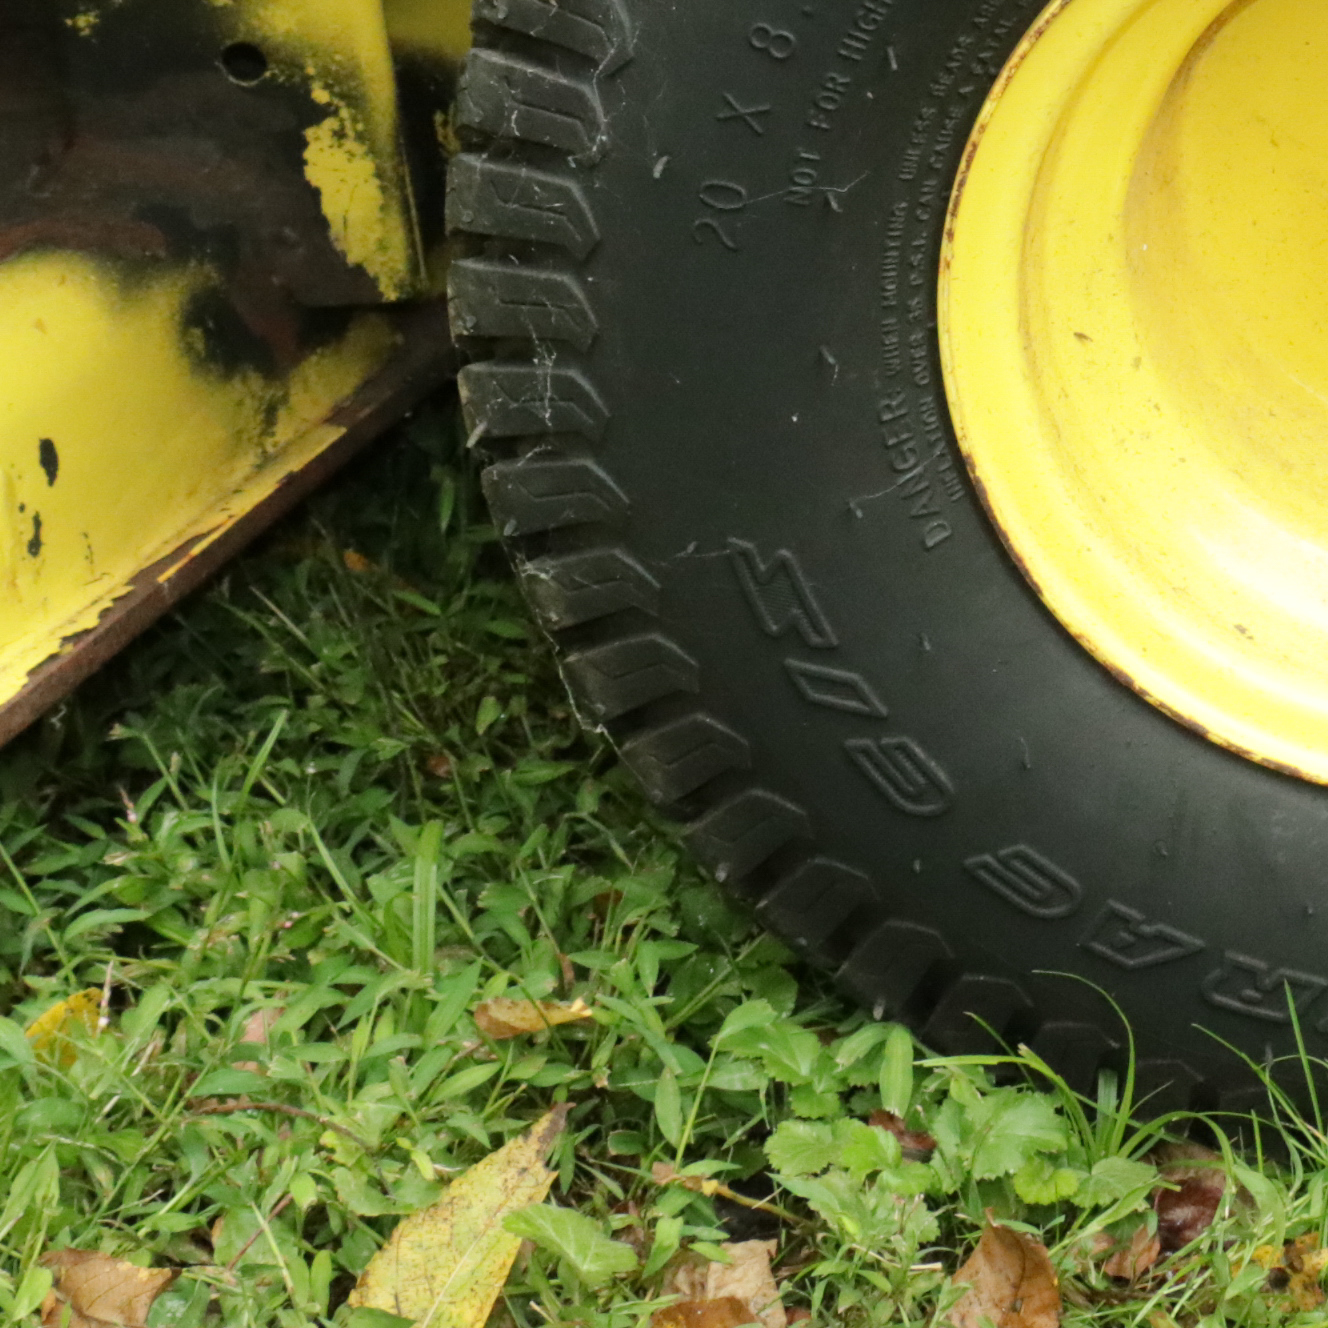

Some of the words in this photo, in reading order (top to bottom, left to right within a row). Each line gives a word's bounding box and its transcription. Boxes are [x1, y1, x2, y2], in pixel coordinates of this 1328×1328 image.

[715, 91, 771, 135] X
[783, 145, 821, 207] NOT
[808, 72, 852, 130] FOR
[693, 179, 748, 252] 20
